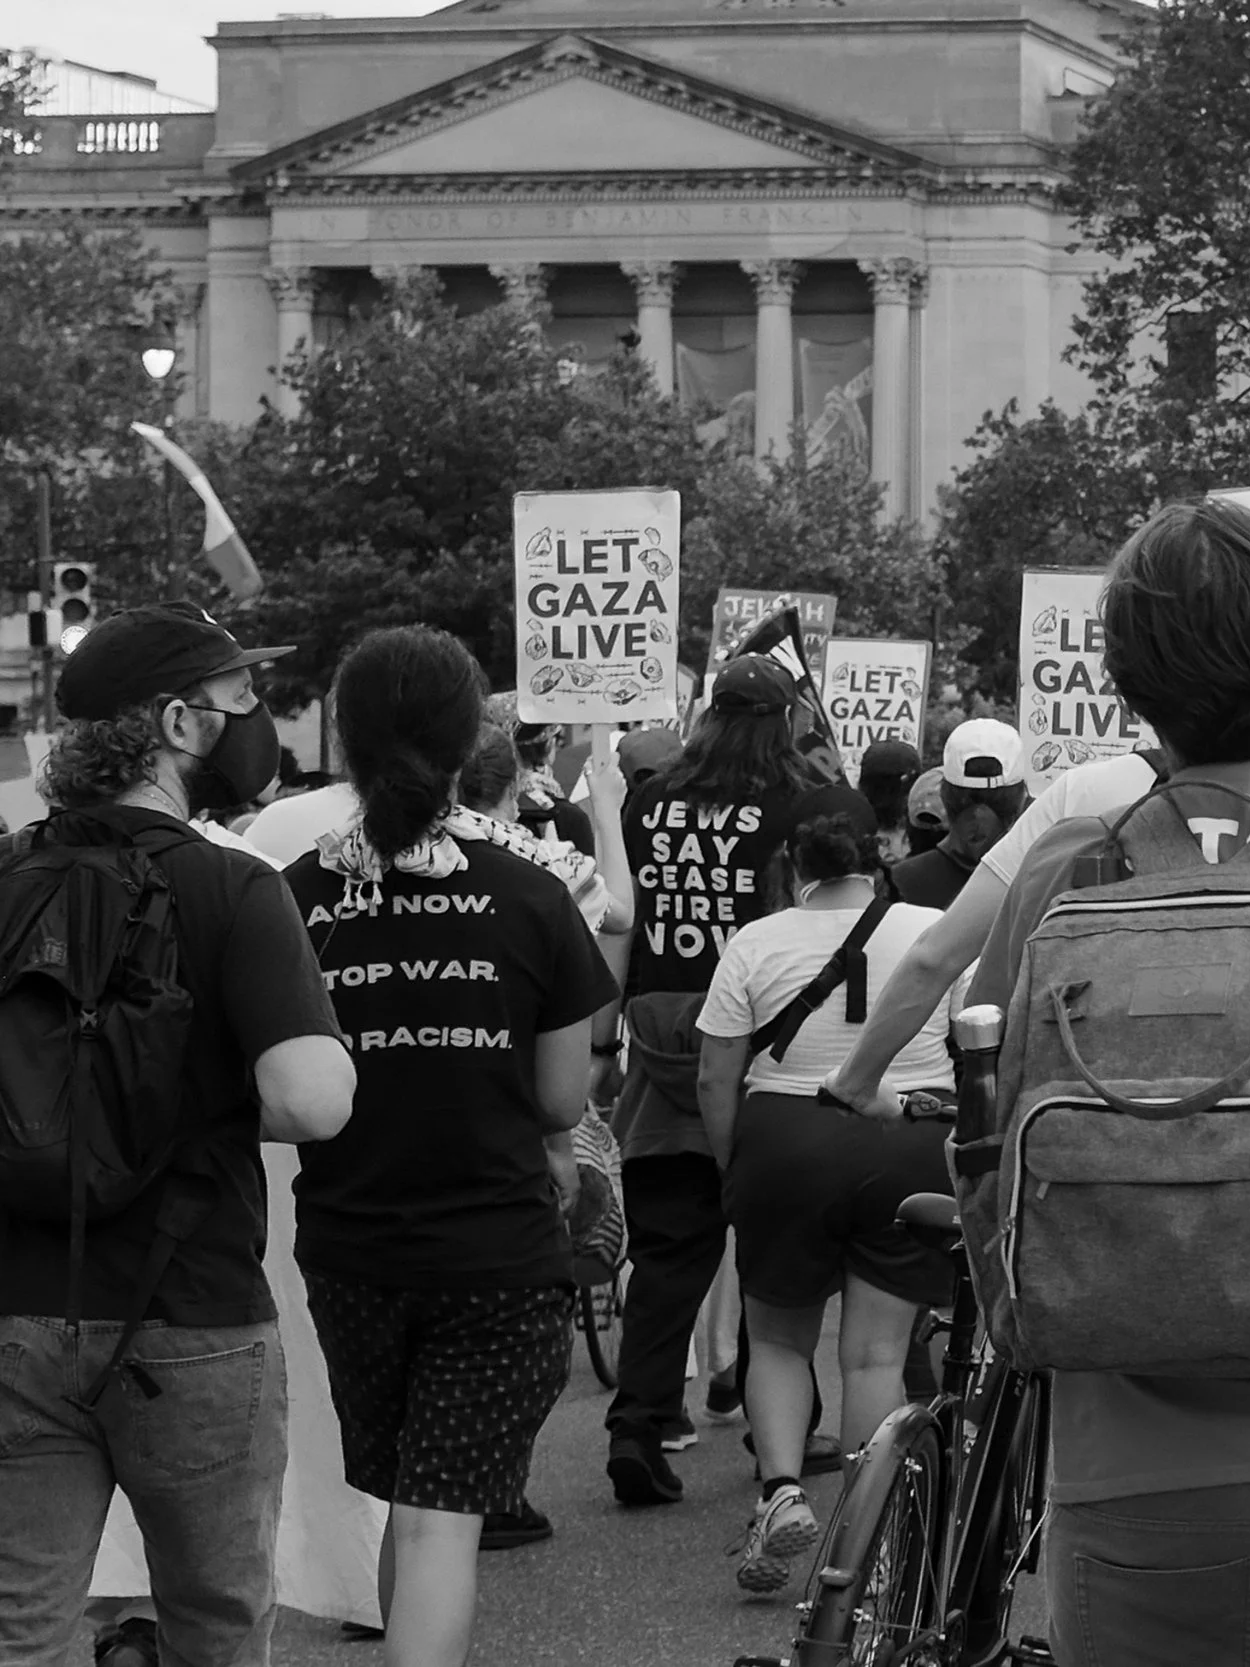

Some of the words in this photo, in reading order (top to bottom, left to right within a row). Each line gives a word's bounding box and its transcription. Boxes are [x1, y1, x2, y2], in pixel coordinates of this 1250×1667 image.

[367, 212, 463, 231] HONOR
[487, 211, 519, 230] OF
[543, 207, 692, 230] BENJAMIN
[722, 205, 862, 225] FRANKLIN
[557, 538, 640, 574] LET
[527, 580, 667, 618] GAZA
[552, 623, 647, 659] LIVE
[1060, 618, 1105, 653] LE
[850, 670, 902, 694] LET
[830, 697, 914, 722] GAZA
[1052, 701, 1140, 739] LIVE
[642, 801, 762, 832] JEWS
[652, 832, 740, 865] SAY
[638, 864, 755, 893] CEASE
[392, 894, 496, 915] NOW.
[656, 893, 735, 921] FIRE
[321, 963, 393, 991] TOP
[400, 960, 499, 982] WAR.
[361, 1026, 512, 1051] RACISM.
